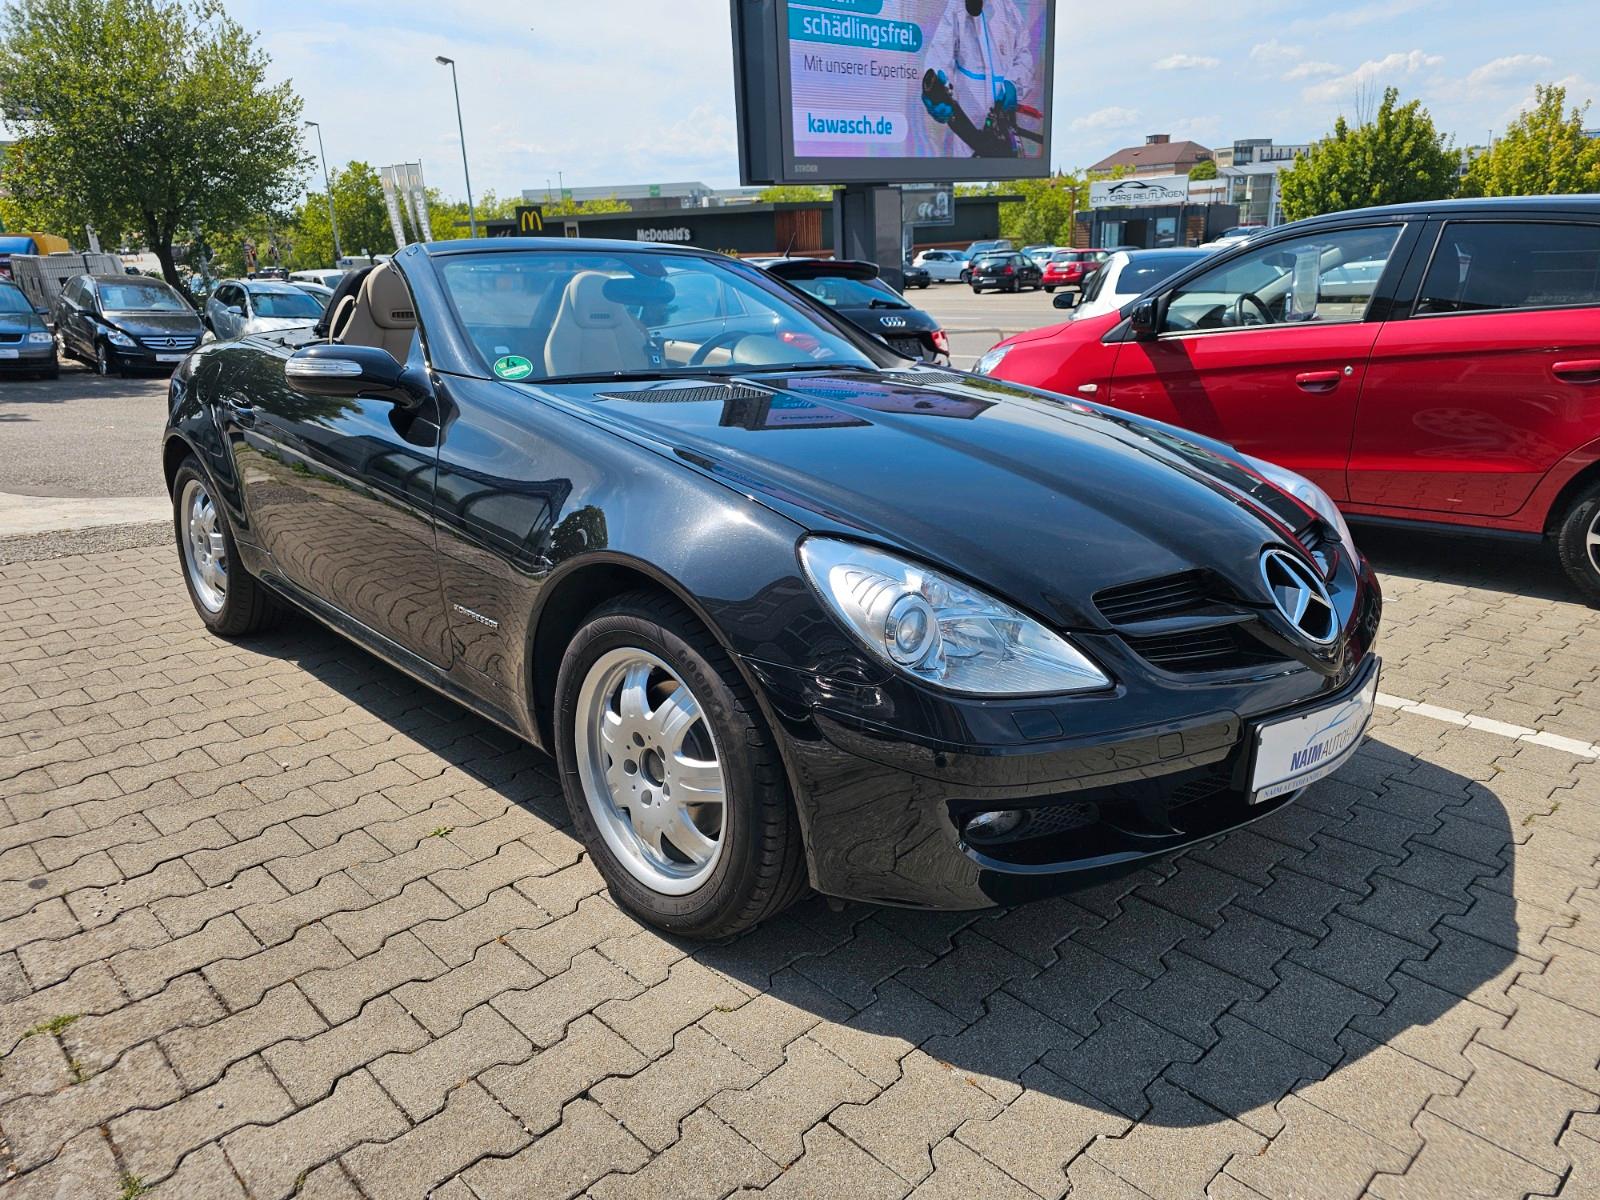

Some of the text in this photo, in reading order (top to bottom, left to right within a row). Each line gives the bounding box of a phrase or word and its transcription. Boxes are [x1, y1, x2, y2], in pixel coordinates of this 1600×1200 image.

[803, 14, 917, 47] schädlingsfrei.
[804, 54, 920, 80] Mit unserer Expertise.
[808, 112, 893, 135] kawasch.de
[1109, 194, 1132, 202] CARS
[1133, 190, 1185, 200] REUTLINGEN
[636, 227, 691, 242] McDonald's
